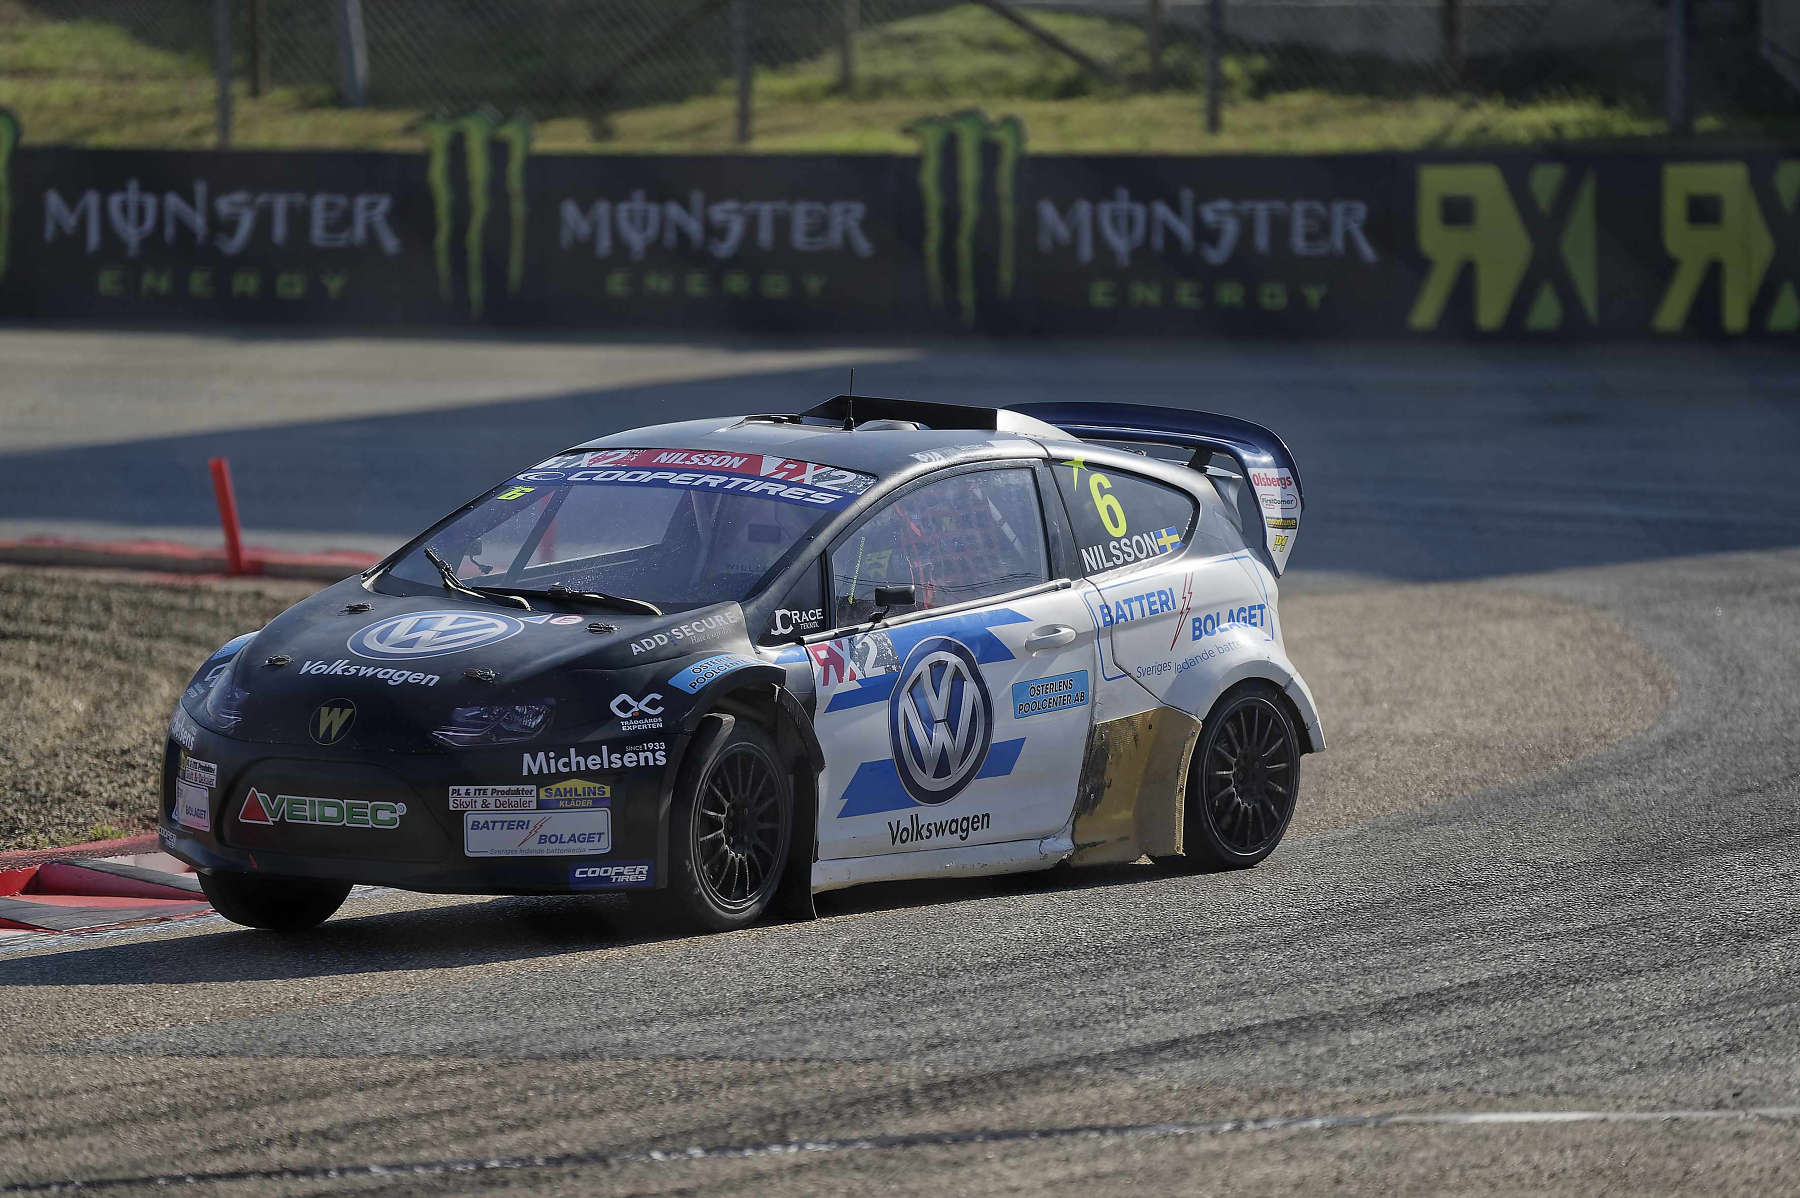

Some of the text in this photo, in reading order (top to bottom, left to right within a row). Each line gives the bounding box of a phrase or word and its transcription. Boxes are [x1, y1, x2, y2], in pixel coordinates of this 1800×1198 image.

[44, 178, 400, 257] MONSTER
[560, 189, 874, 260] MONSTER
[1037, 186, 1378, 267] MONSTER
[101, 268, 348, 297] ENERGY
[1090, 280, 1328, 308] ENERGY
[652, 451, 749, 469] NILSSON
[1252, 473, 1293, 489] Olsbergs
[1089, 473, 1127, 538] 6
[1081, 532, 1160, 572] NILSSON
[791, 608, 824, 624] RACE
[1098, 588, 1177, 627] BATTERI
[630, 633, 668, 656] ADD
[671, 611, 738, 640] SECURE
[1192, 604, 1266, 641] BOLAGET
[299, 659, 441, 687] Volkswagen
[1137, 660, 1172, 679] Sveriges
[1174, 649, 1216, 675] ledande
[1029, 679, 1074, 698] ÖSTERLENS
[1018, 691, 1085, 715] POOLCENTER AB
[621, 722, 663, 731] EXPERTEN
[642, 742, 666, 750] 1933
[522, 745, 667, 776] Michelsens
[450, 786, 534, 797] PL & ITE Produkter
[451, 798, 533, 809] Skylt & Dekaler
[544, 785, 606, 798] SAHLINS
[470, 820, 531, 832] BATTERI
[536, 831, 605, 846] BOLAGET
[888, 811, 991, 847] Volkswagen
[574, 865, 649, 878] COOPER
[610, 874, 647, 883] TIRES
